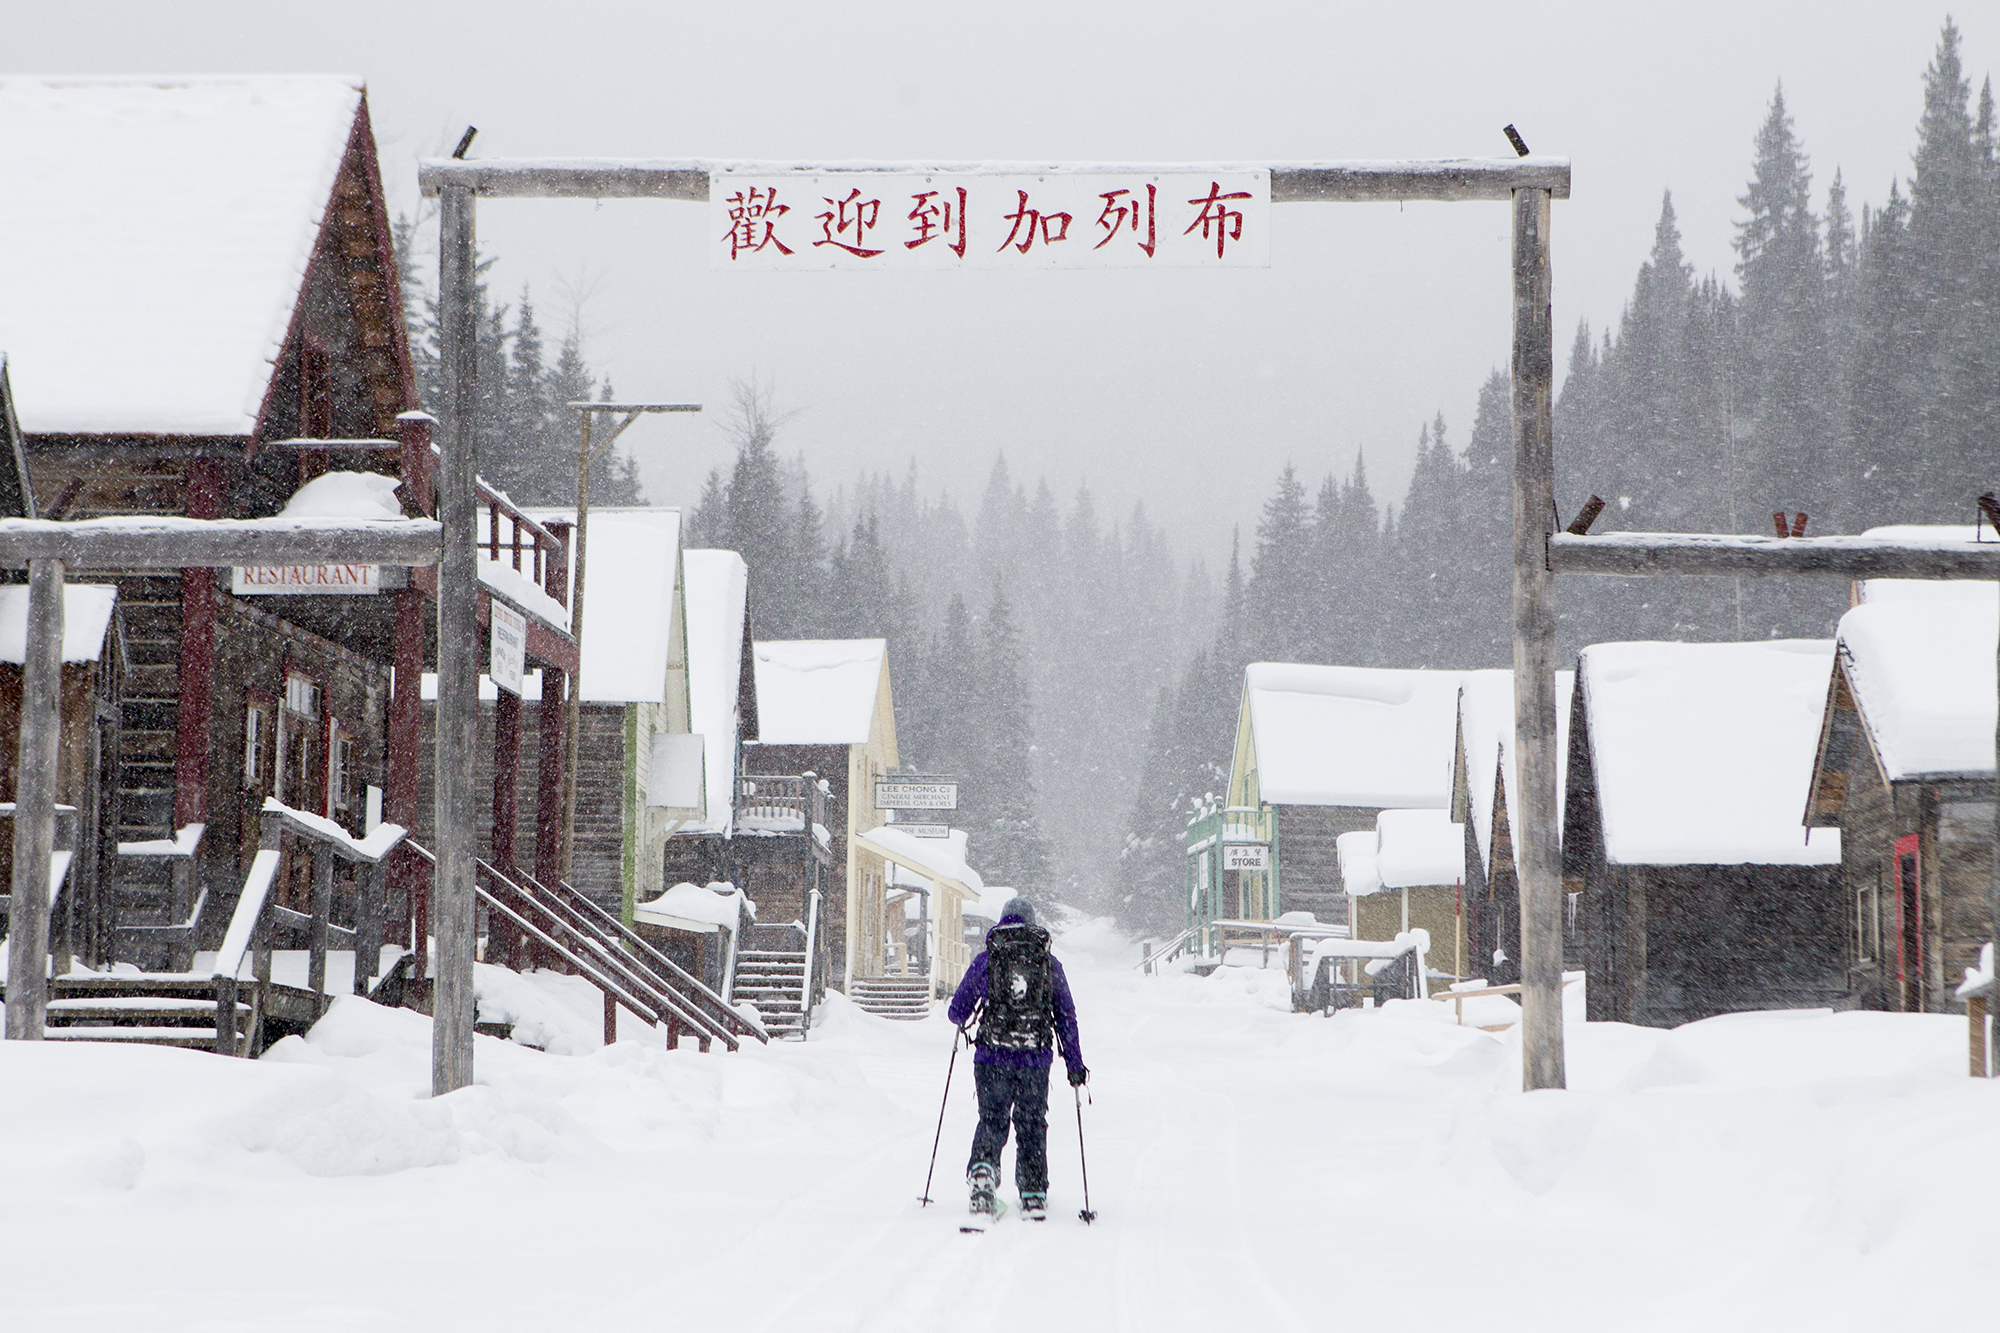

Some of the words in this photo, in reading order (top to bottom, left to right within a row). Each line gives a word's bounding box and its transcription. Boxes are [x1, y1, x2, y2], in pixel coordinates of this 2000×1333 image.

[720, 181, 1254, 261] 歡迎到加列布
[243, 564, 371, 585] RESTAURANT
[881, 785, 899, 793] LEE
[902, 785, 937, 793] CHONG
[1231, 857, 1261, 867] STORE
